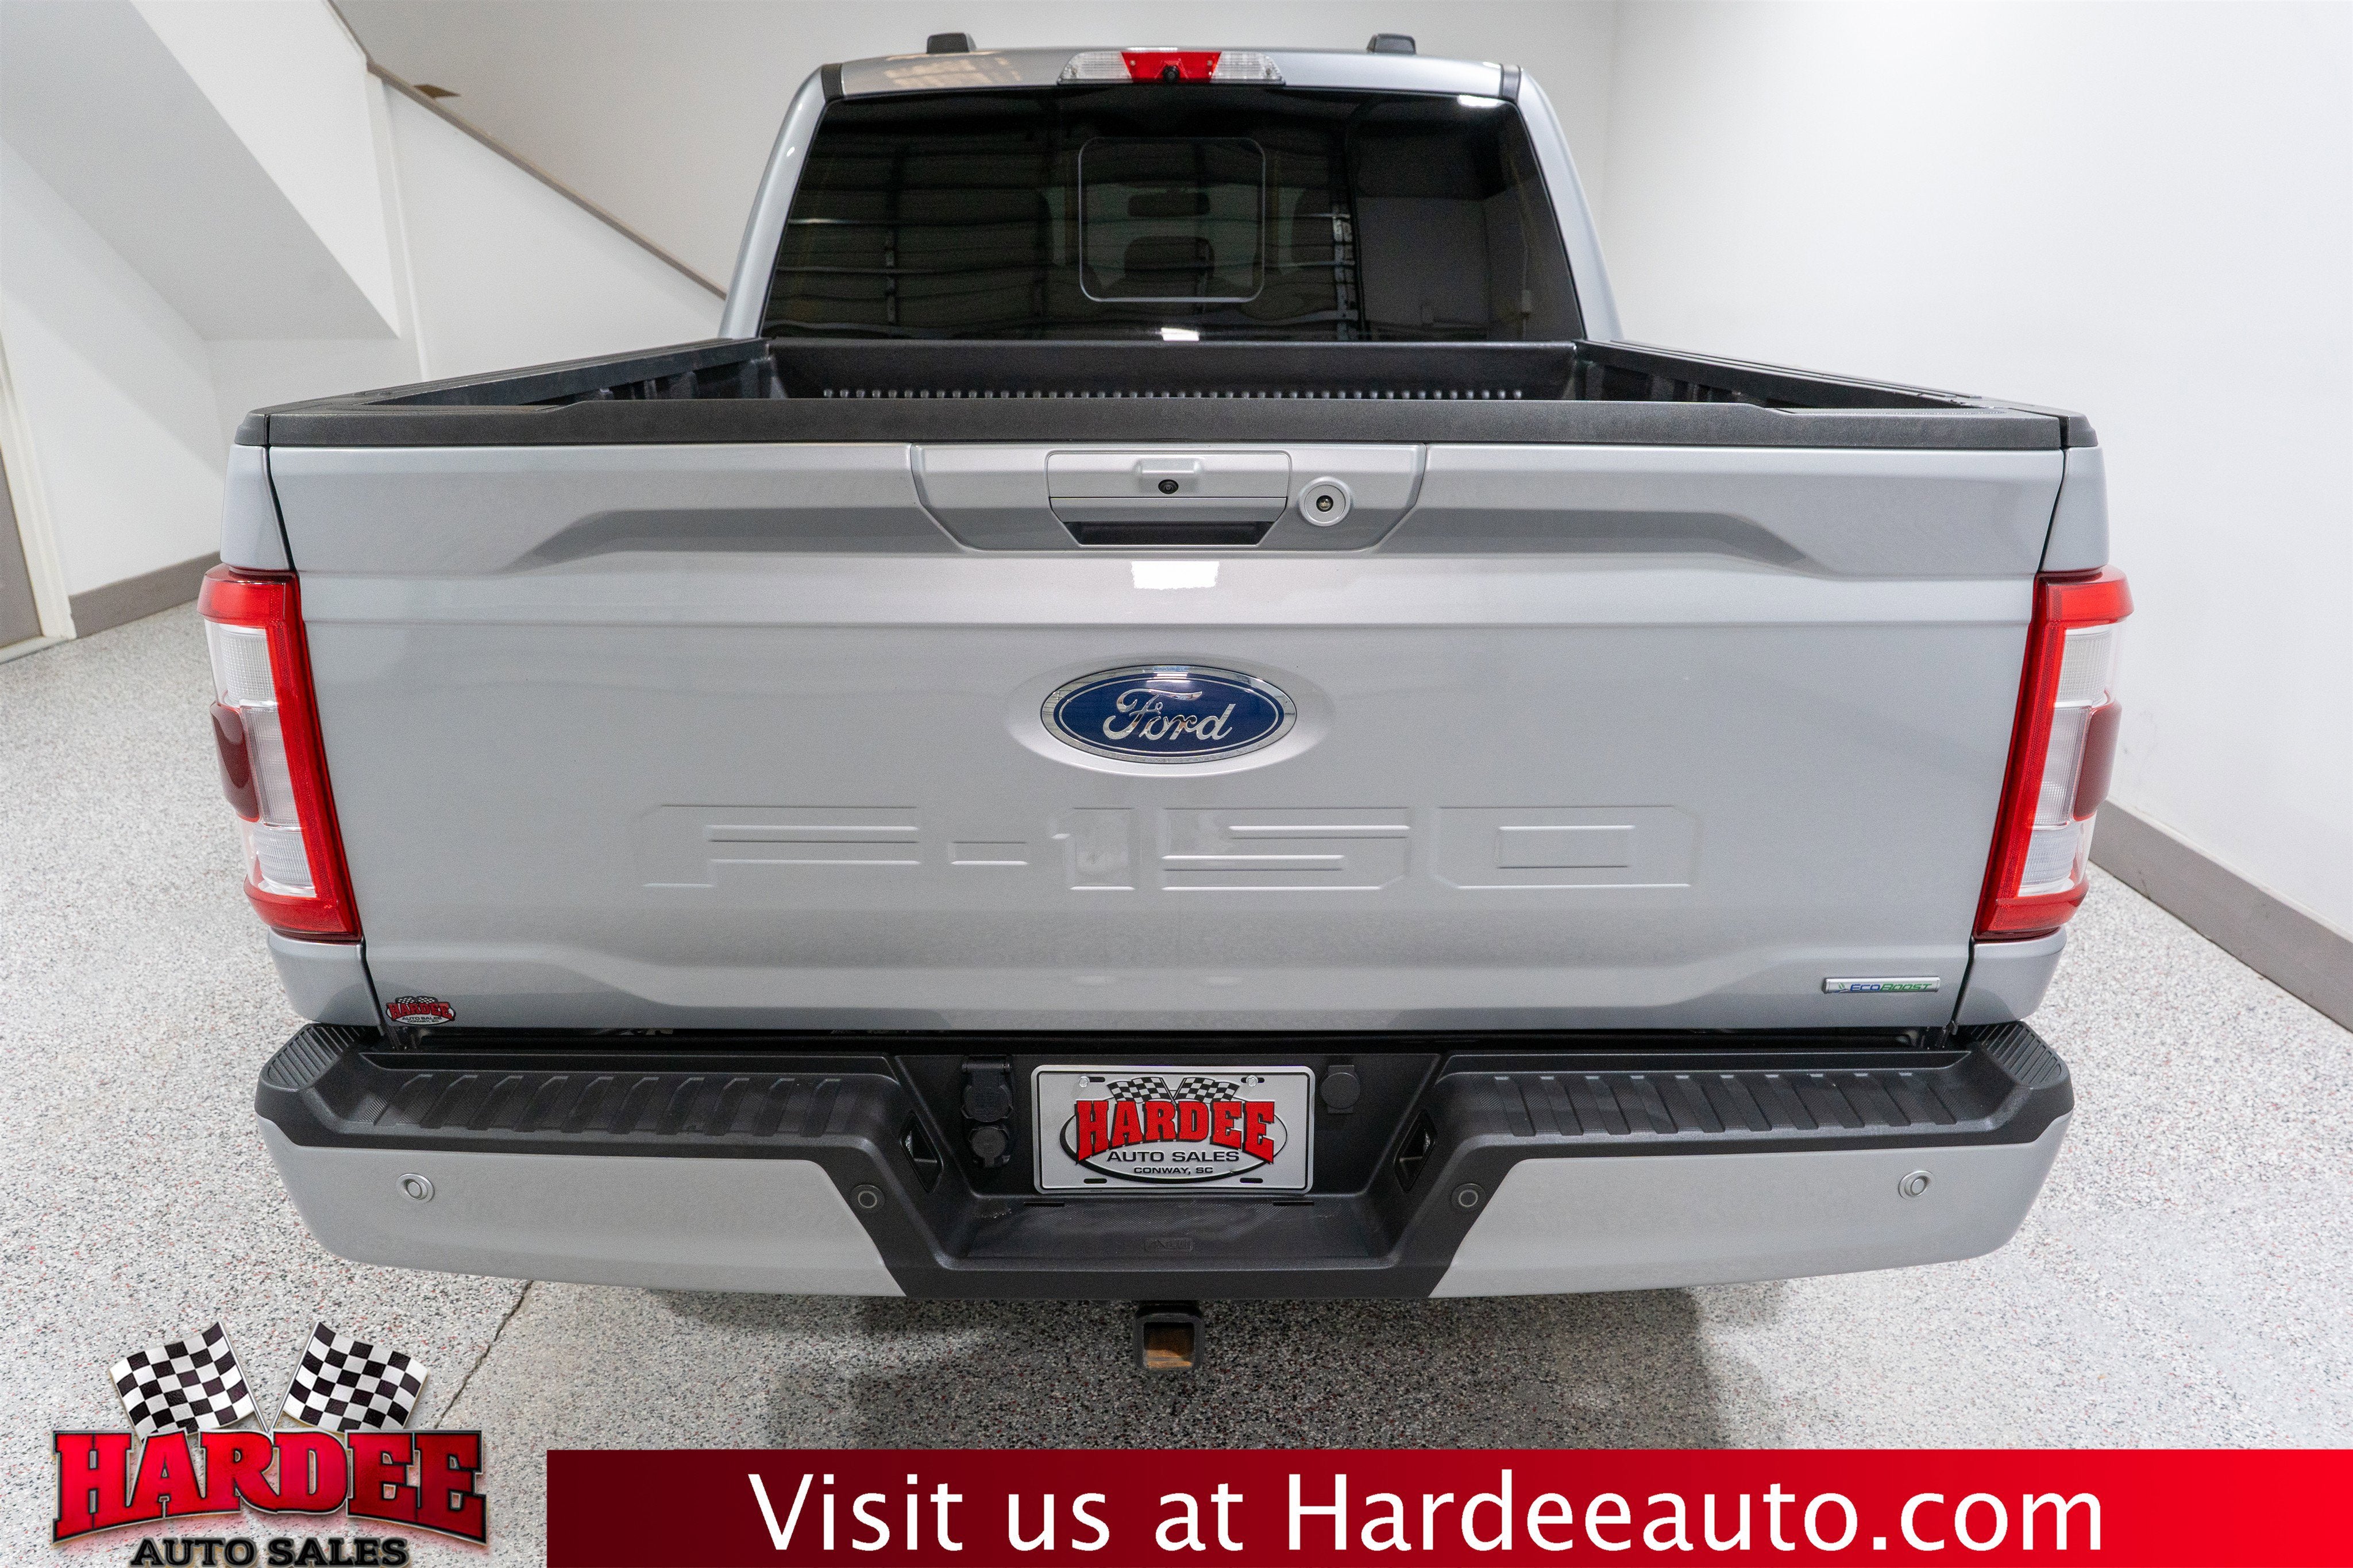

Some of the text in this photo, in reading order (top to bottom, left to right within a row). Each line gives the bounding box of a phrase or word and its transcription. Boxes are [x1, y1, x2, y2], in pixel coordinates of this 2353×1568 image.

[1103, 689, 1236, 740] Ford
[634, 804, 1696, 891] F-150
[1850, 983, 1932, 992] ECOBOOST
[387, 1002, 453, 1021] HARDEE
[1075, 1100, 1274, 1164] HARDEE
[1107, 1150, 1239, 1162] AUTO SALES
